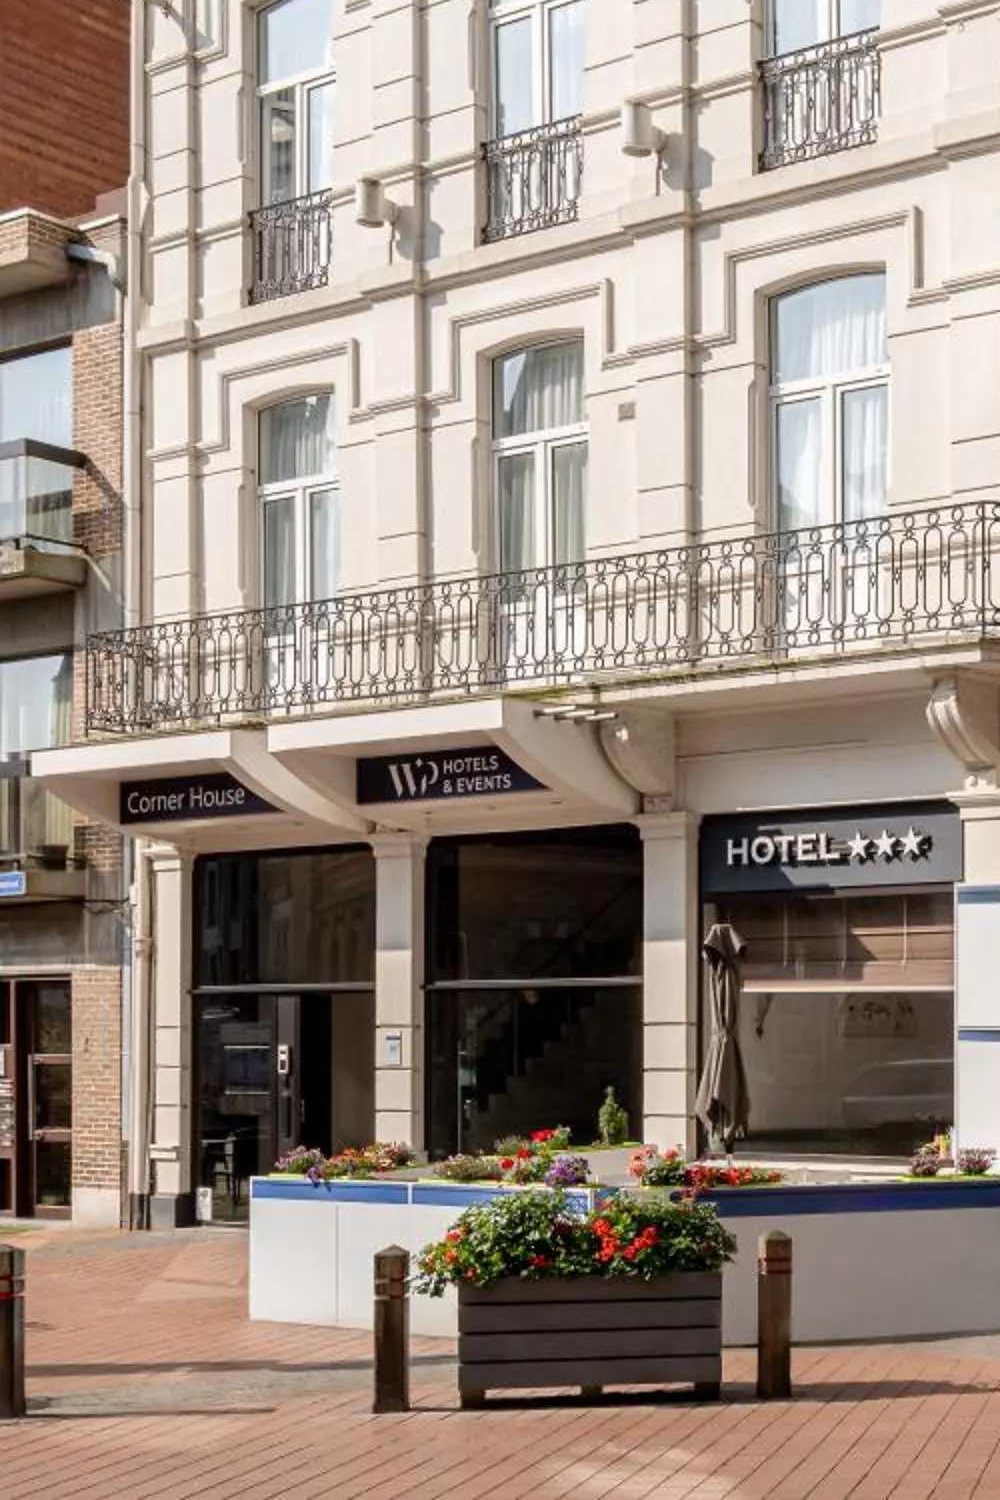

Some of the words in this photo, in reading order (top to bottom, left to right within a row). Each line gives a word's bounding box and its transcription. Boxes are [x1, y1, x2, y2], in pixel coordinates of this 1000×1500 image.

[443, 755, 499, 775] HOTELS
[443, 779, 451, 794] &
[457, 774, 512, 794] EVENTS
[127, 791, 185, 814] Corner
[189, 786, 246, 808] House
[726, 832, 841, 866] HOTEL
